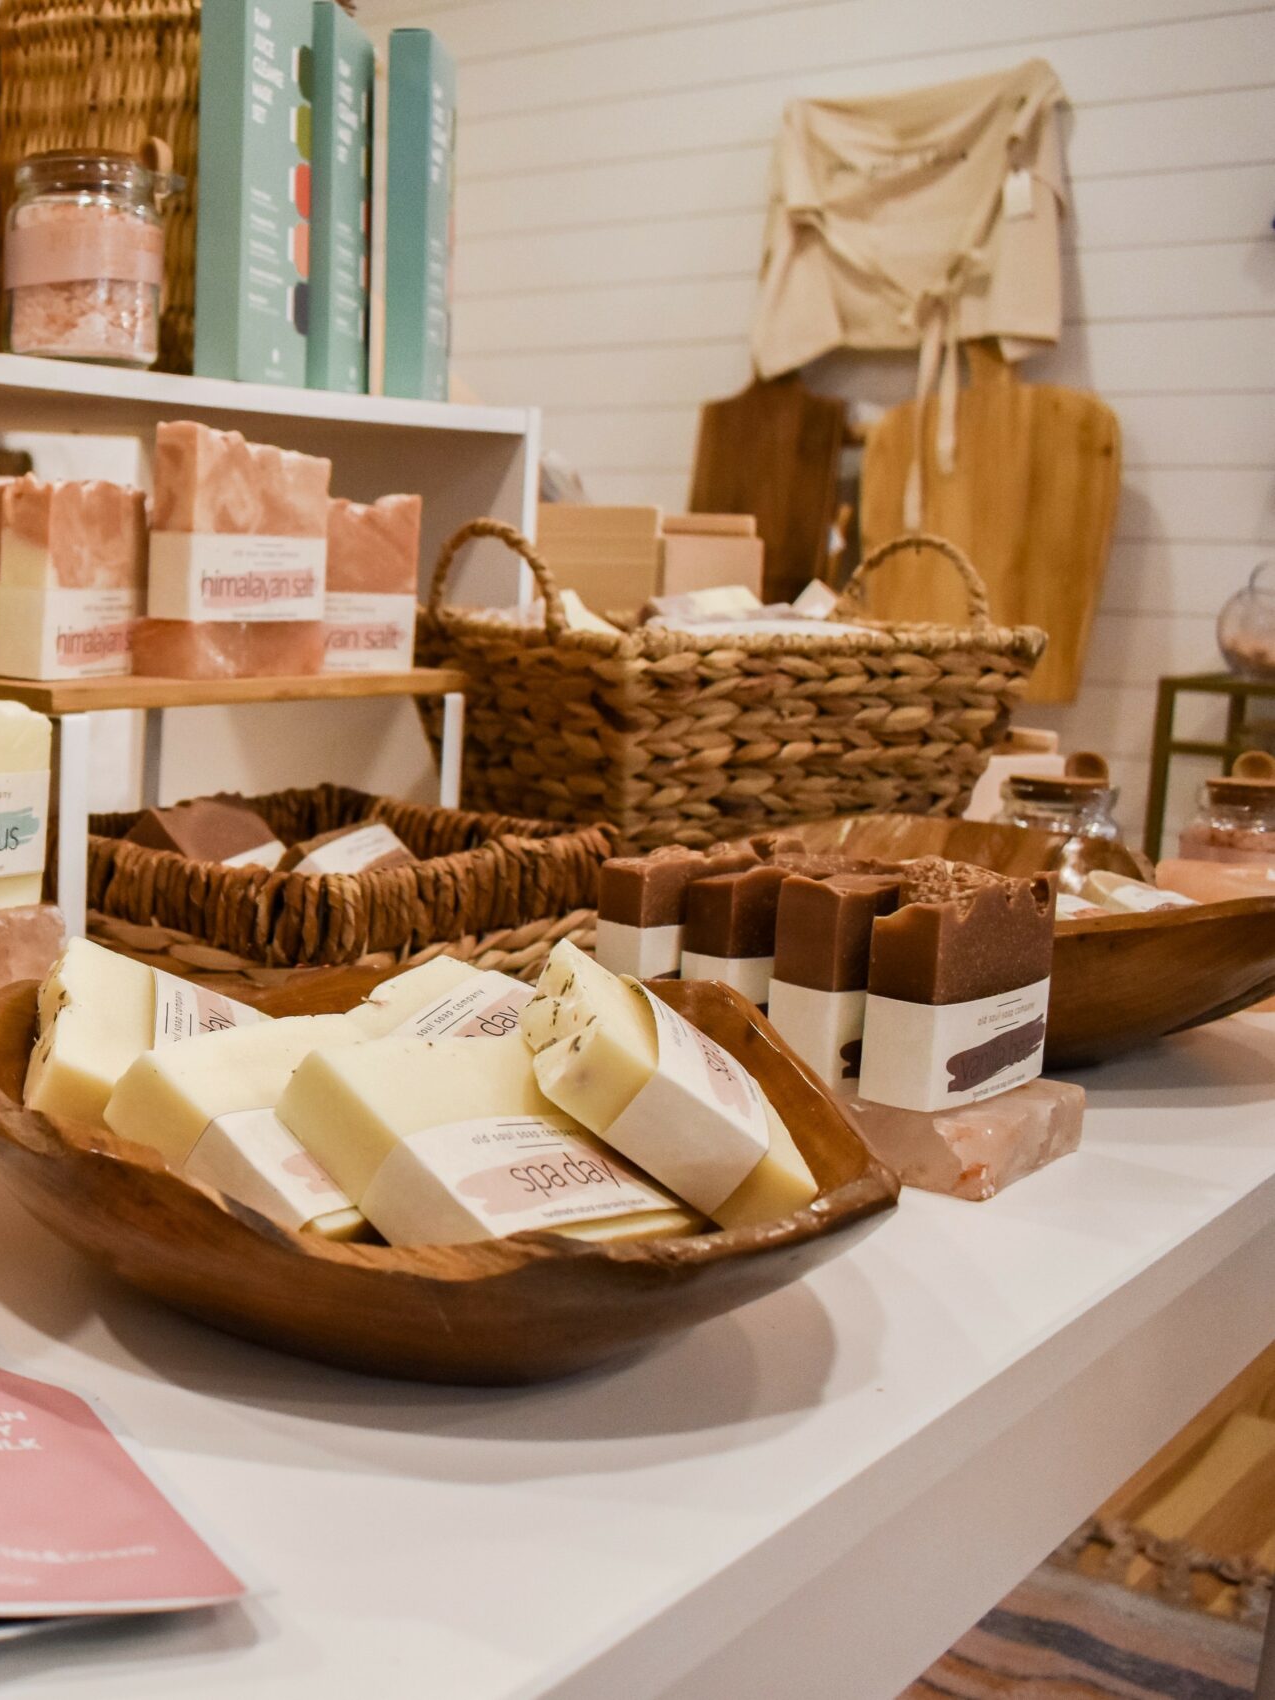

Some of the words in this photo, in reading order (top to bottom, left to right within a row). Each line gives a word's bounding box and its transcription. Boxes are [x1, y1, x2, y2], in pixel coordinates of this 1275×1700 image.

[200, 569, 289, 602] himalayan
[292, 567, 314, 598] salt
[365, 623, 398, 650] salt
[416, 1022, 435, 1038] soul
[434, 1009, 454, 1024] soap
[475, 1005, 520, 1037] day
[471, 1132, 491, 1145] old
[493, 1130, 516, 1141] soul
[518, 1129, 540, 1139] soap
[510, 1163, 568, 1198] spa
[563, 1152, 621, 1188] day
